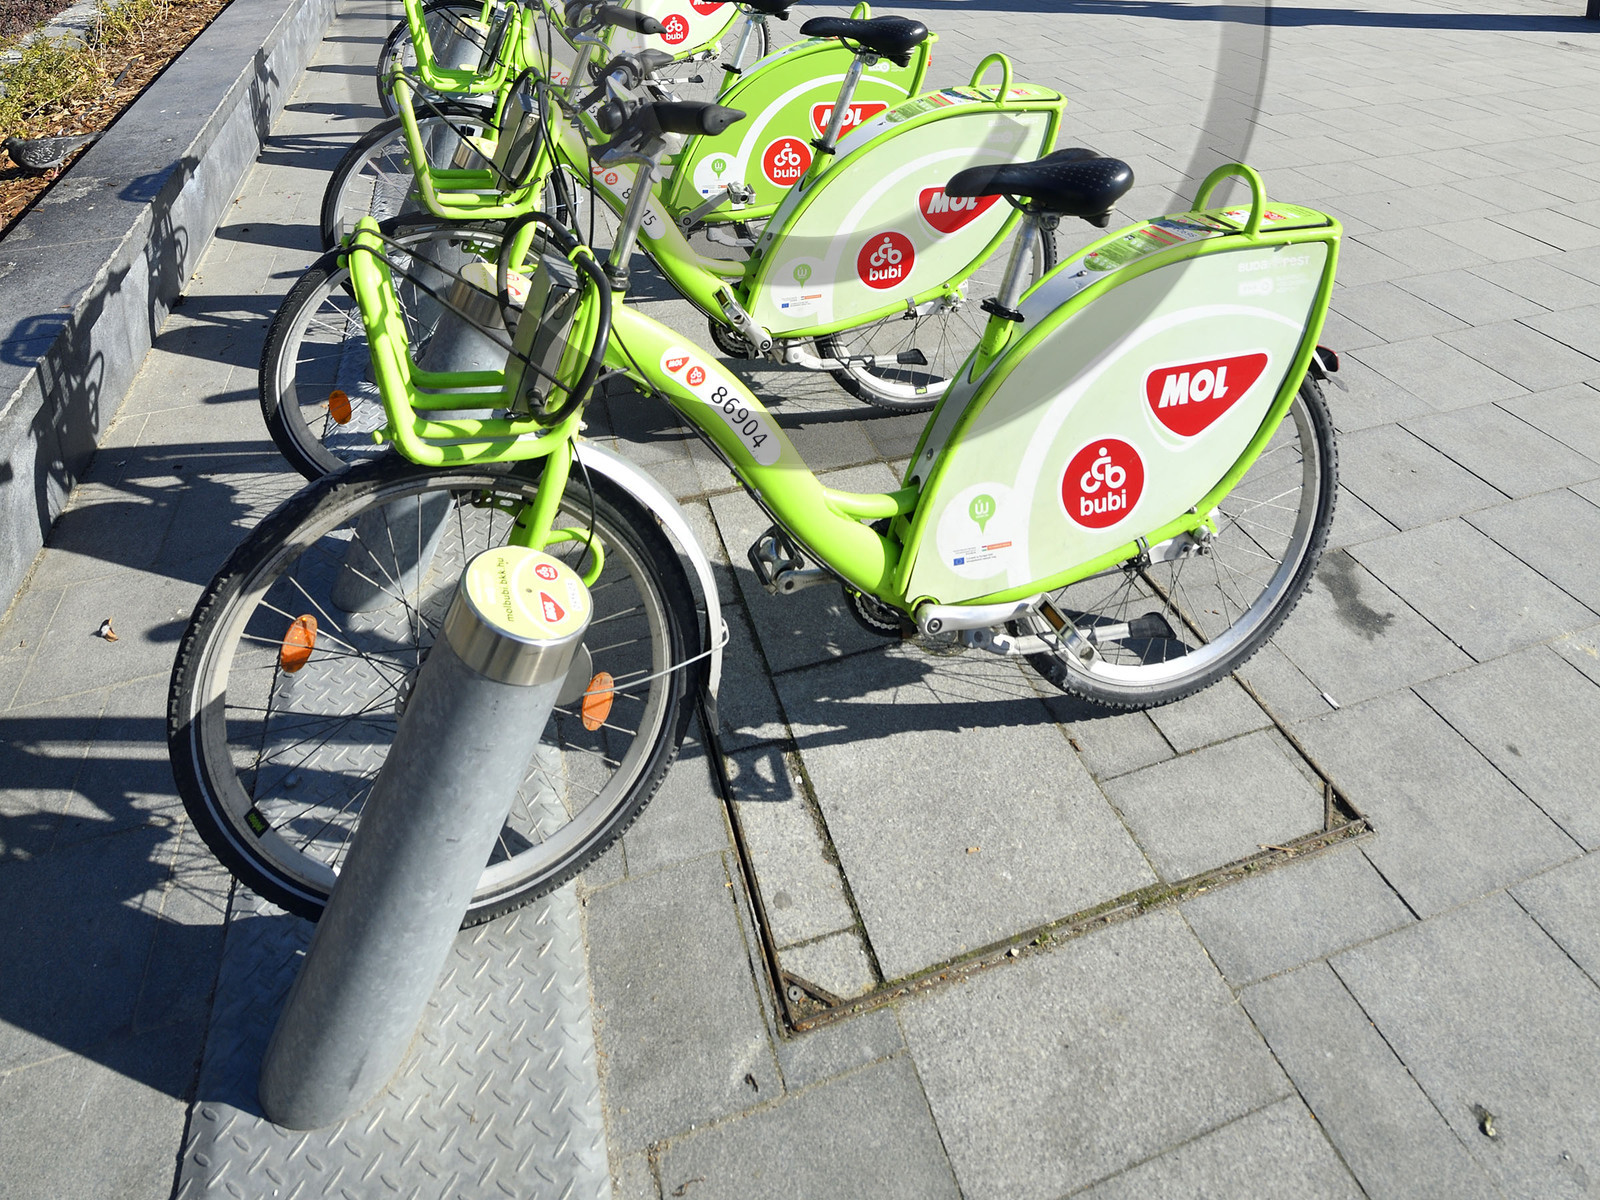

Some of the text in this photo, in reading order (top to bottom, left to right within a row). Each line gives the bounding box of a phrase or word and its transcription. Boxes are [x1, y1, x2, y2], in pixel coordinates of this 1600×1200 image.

[665, 32, 684, 41] bubi
[773, 167, 801, 179] bubi
[868, 258, 903, 280] bubi
[1157, 367, 1230, 409] MOL
[710, 386, 768, 448] 86904
[1079, 488, 1128, 518] bubi
